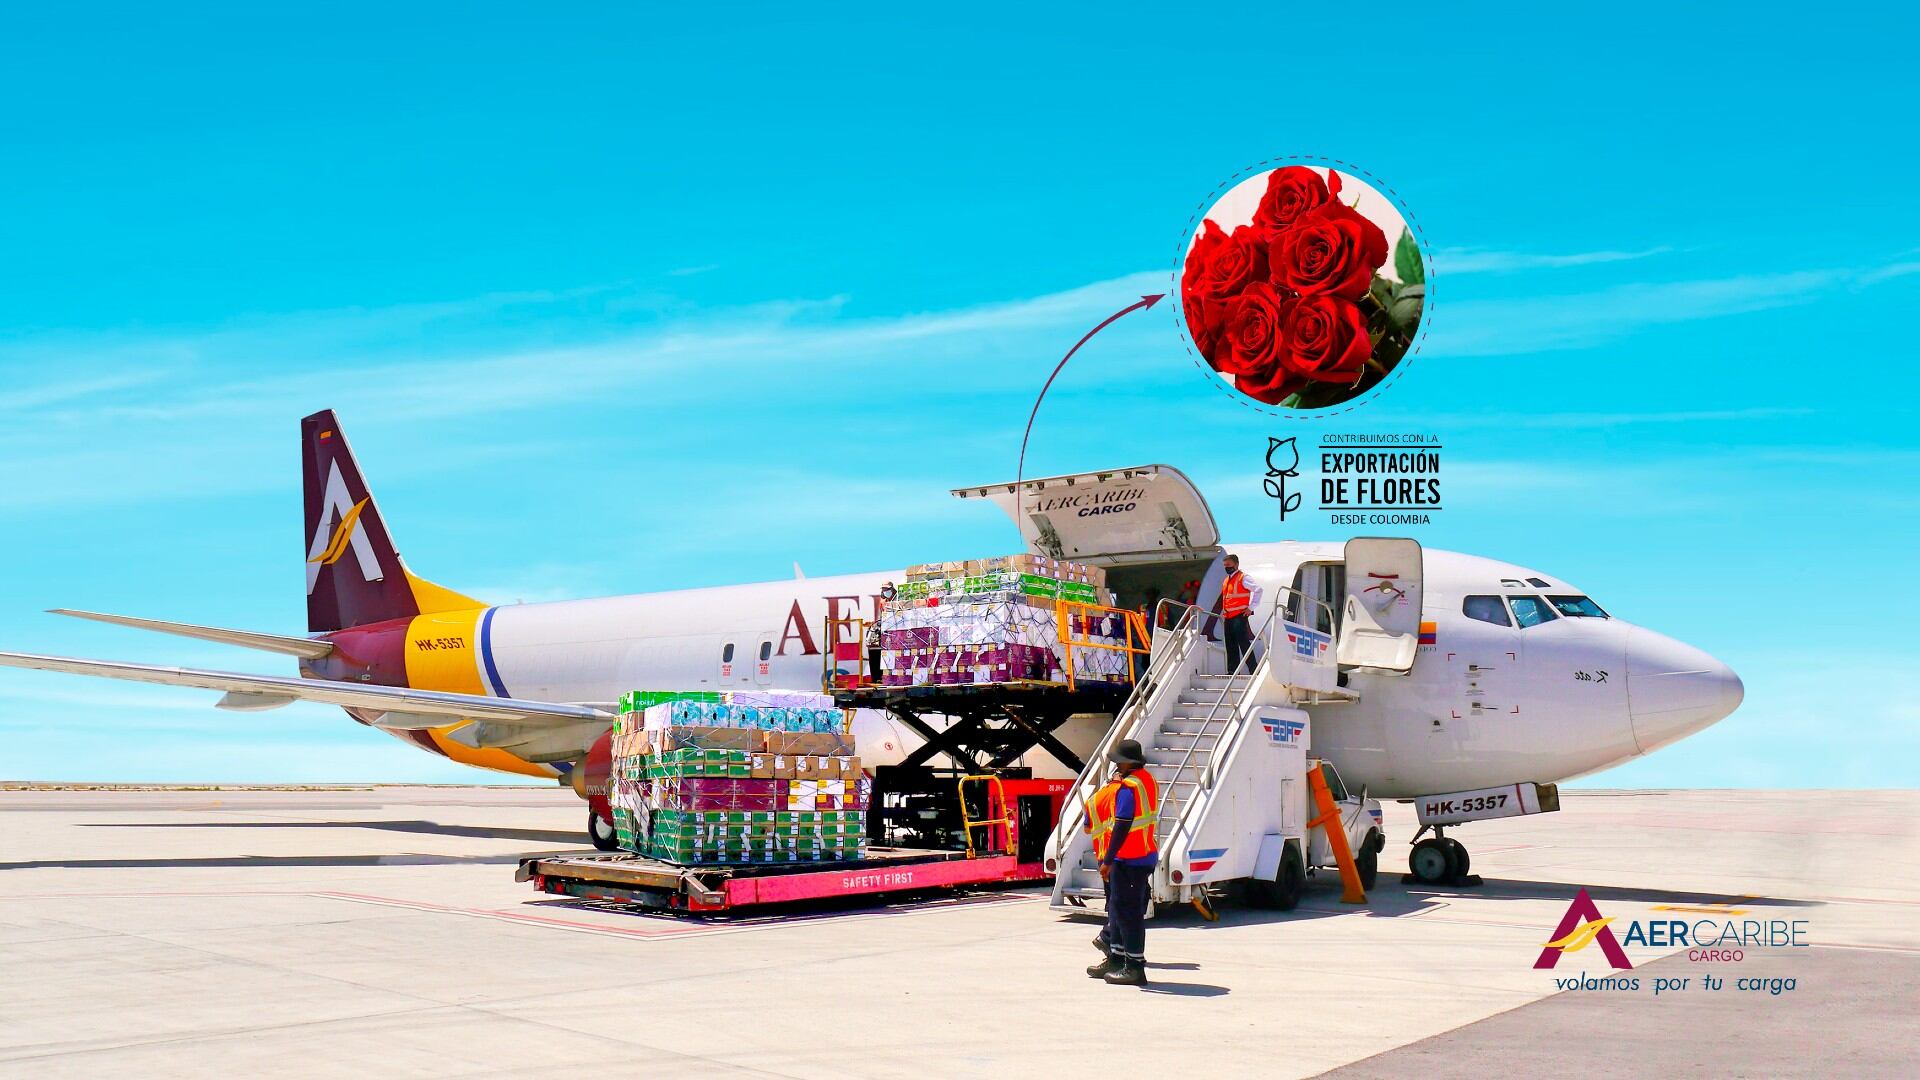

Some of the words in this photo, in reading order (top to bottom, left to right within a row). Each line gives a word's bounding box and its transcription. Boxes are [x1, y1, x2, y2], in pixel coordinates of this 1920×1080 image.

[1078, 502, 1137, 517] CARGO
[415, 638, 465, 651] HK-5357
[1426, 795, 1508, 816] HK-5357
[843, 875, 881, 888] SAFETY
[884, 872, 913, 885] FIRST
